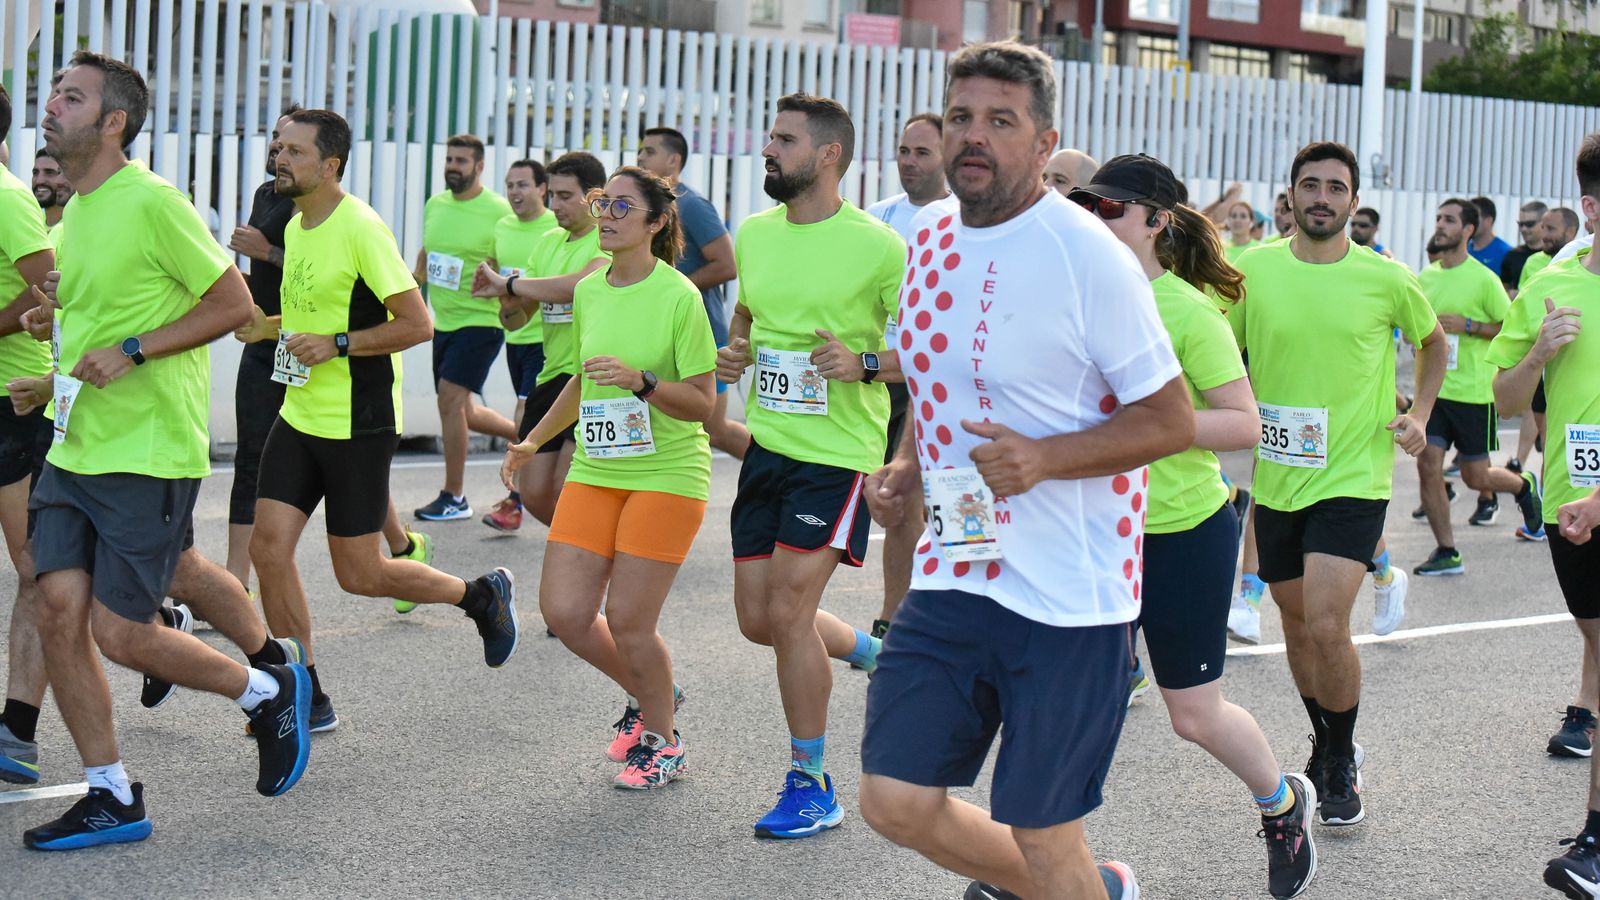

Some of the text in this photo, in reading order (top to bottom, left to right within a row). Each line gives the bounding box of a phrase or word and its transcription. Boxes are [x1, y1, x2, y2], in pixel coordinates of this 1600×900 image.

[276, 348, 292, 369] 512
[760, 370, 789, 395] 579
[582, 404, 594, 415] XXI
[586, 420, 616, 443] 578
[1261, 424, 1289, 449] 535
[1569, 430, 1584, 441] XXI
